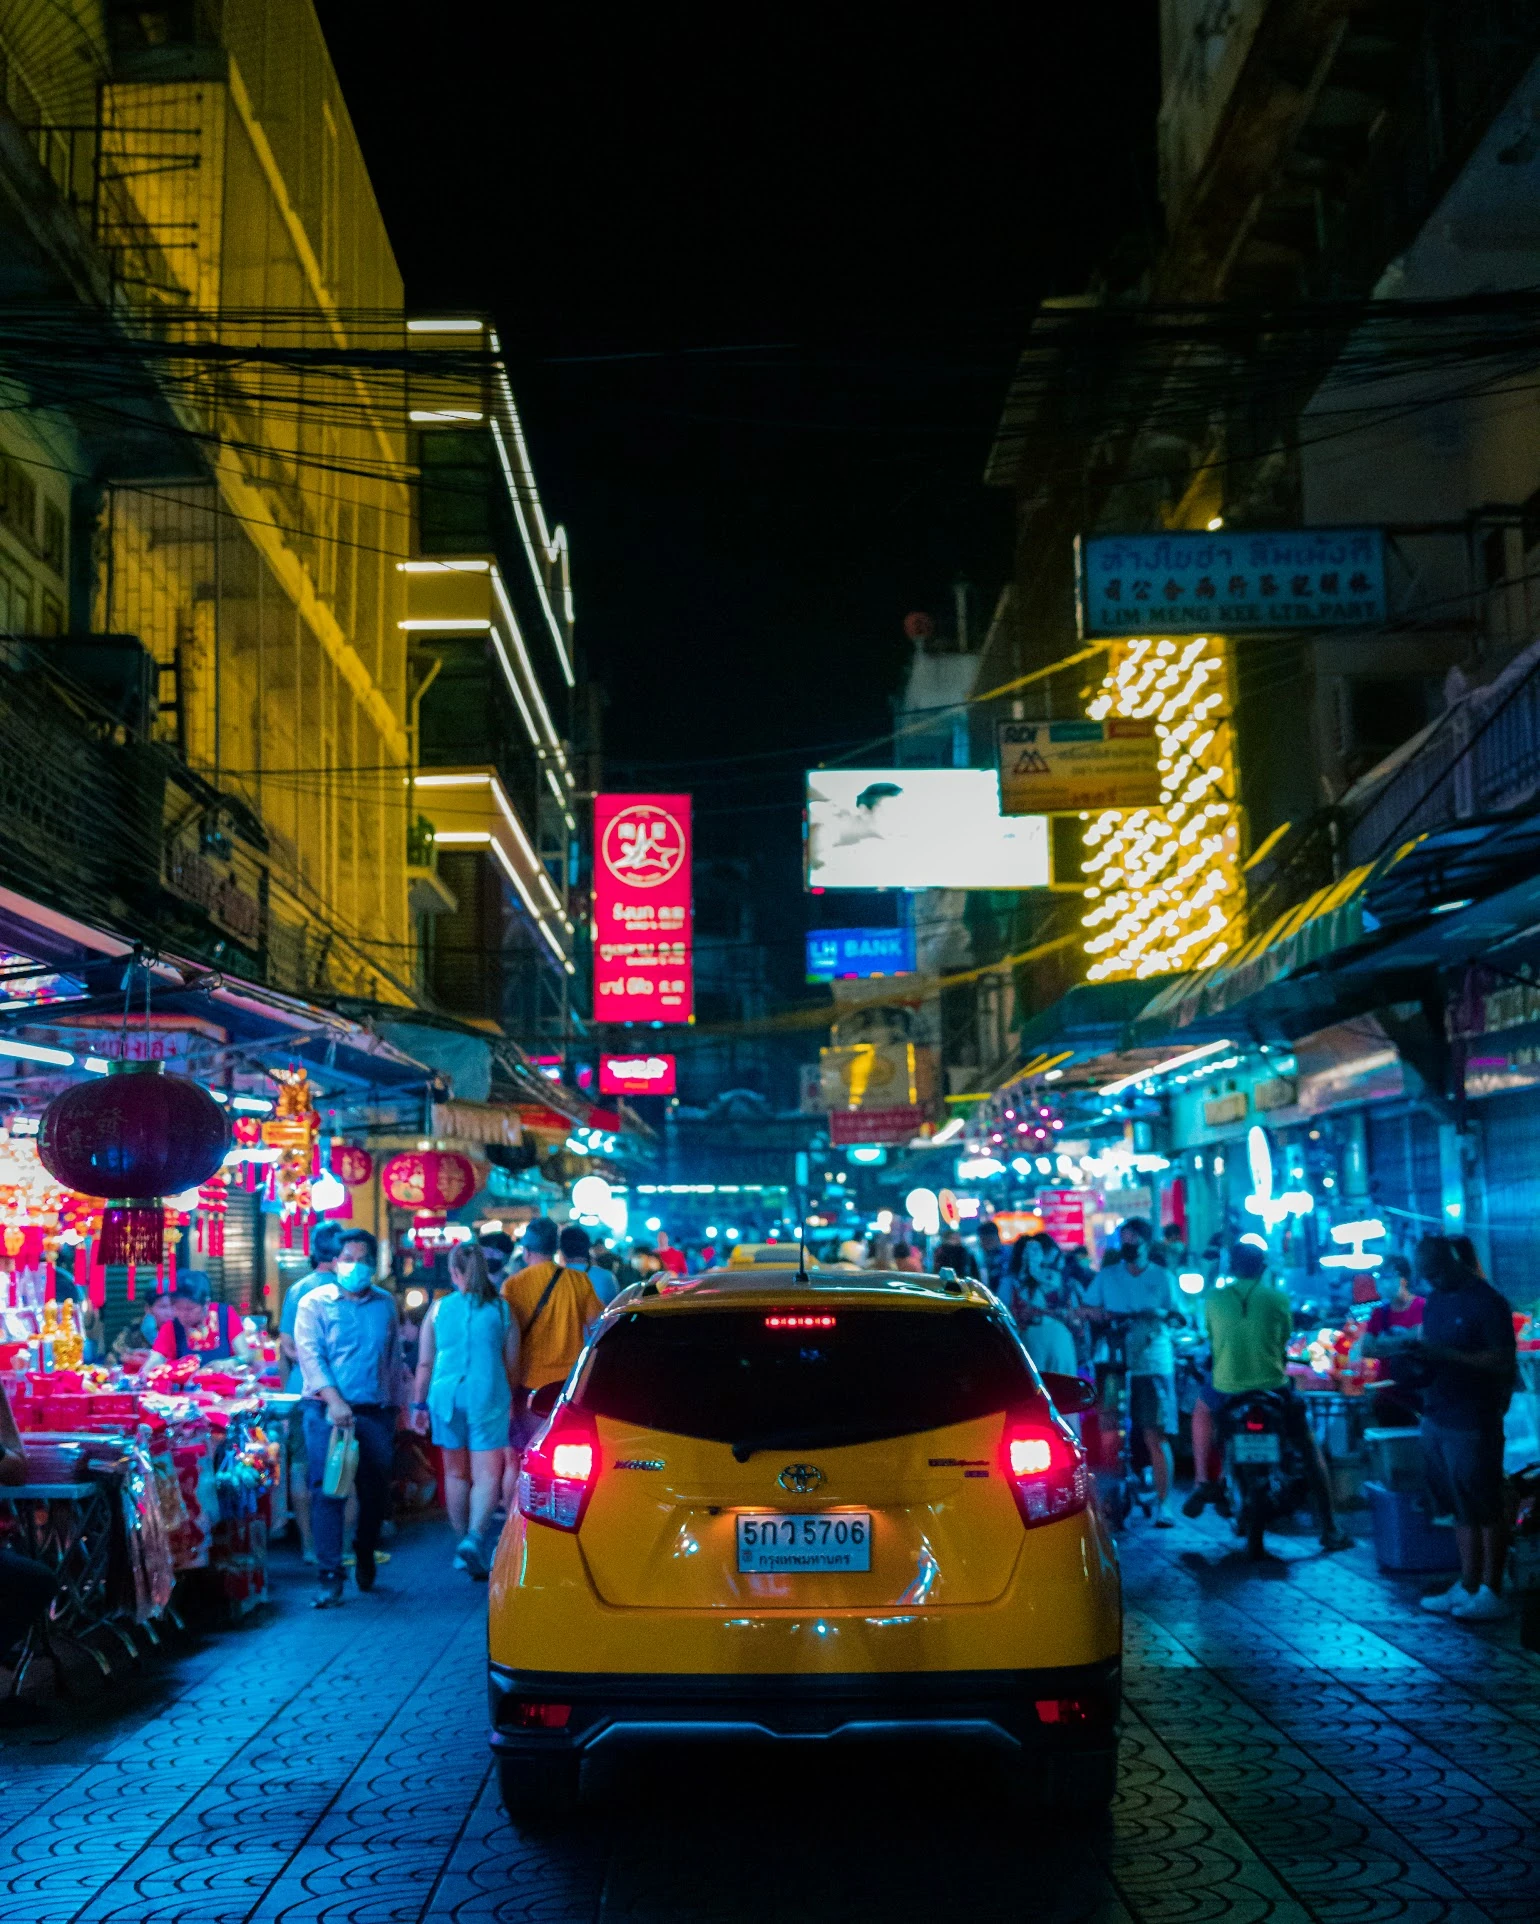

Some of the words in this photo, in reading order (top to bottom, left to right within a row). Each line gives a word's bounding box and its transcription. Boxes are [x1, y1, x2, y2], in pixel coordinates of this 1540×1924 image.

[1103, 607, 1140, 625] LIM
[1149, 606, 1211, 623] MENG
[1219, 604, 1257, 621] KEE
[809, 940, 837, 958] LH
[844, 939, 902, 958] BANK
[743, 1520, 796, 1546] 5กว
[803, 1519, 865, 1545] 5706
[759, 1553, 851, 1570] กรุงเทพมหานคร
